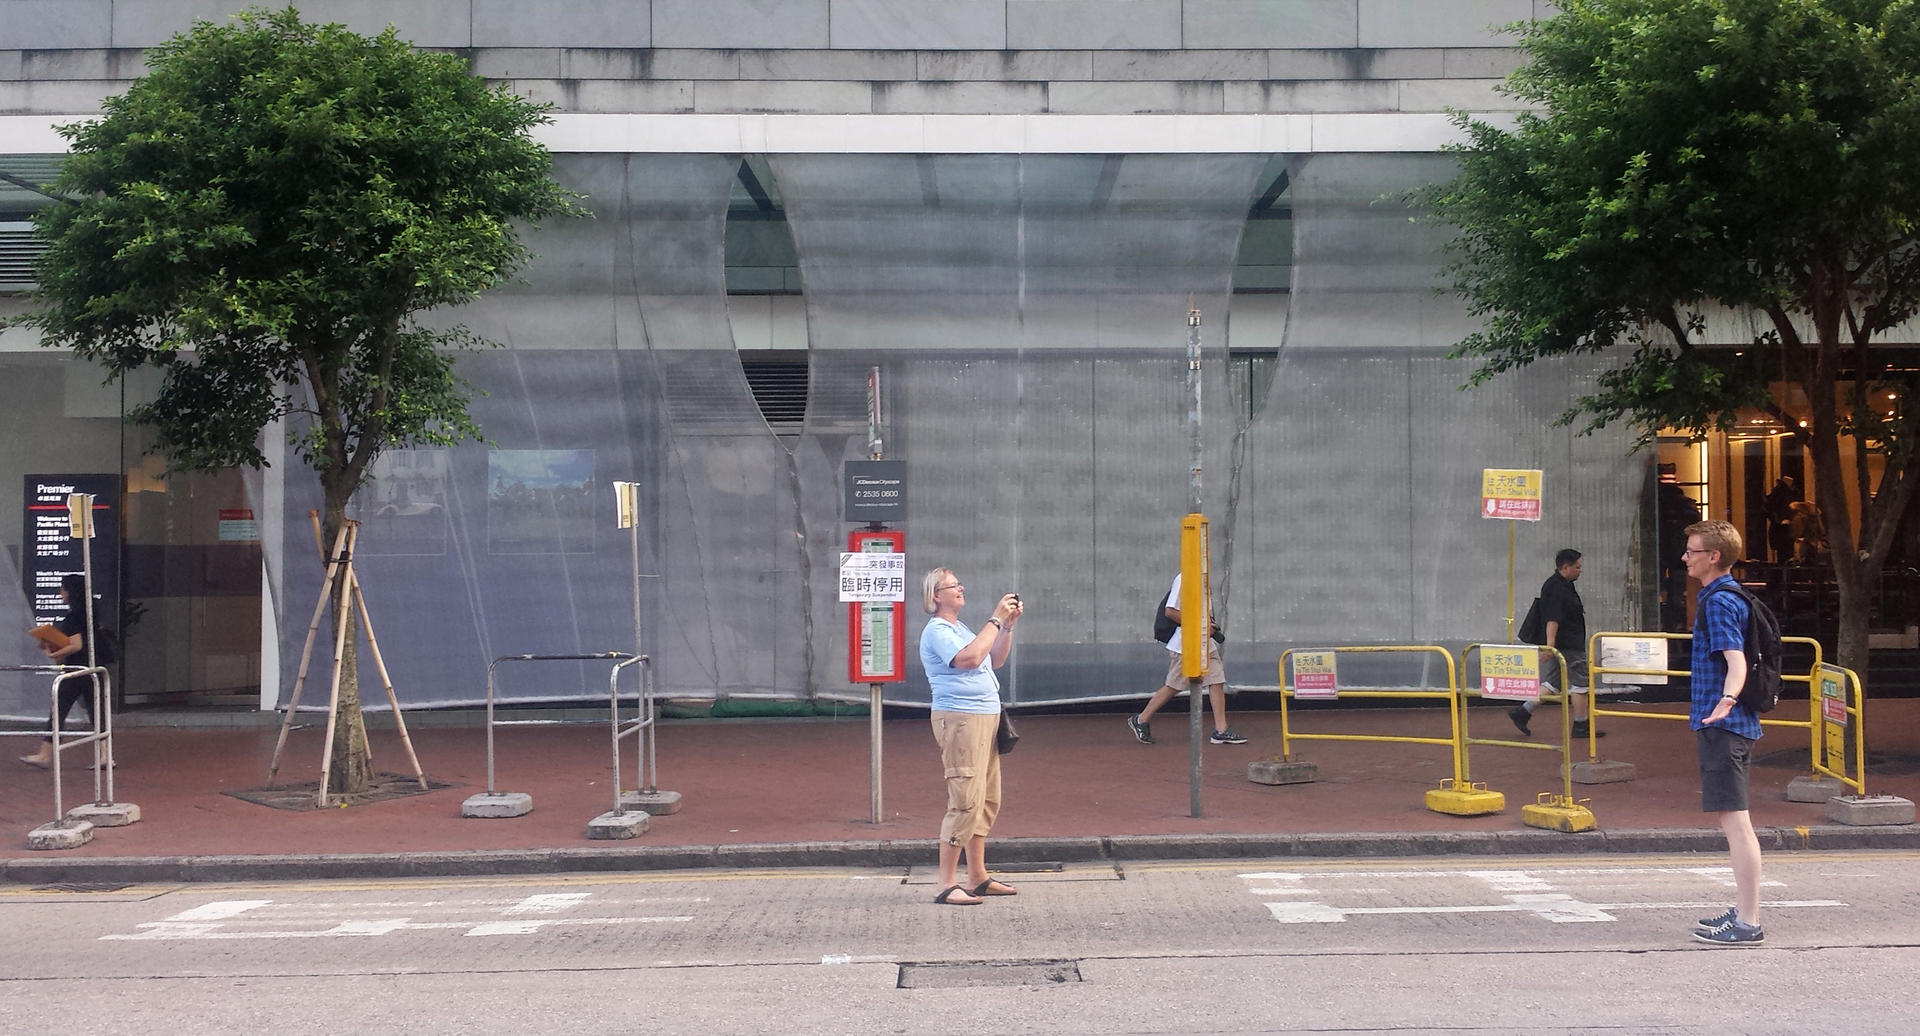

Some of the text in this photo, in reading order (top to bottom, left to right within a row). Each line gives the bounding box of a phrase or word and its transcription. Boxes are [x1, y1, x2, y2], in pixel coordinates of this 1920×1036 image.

[37, 484, 75, 494] Premier
[1496, 488, 1506, 496] Tin
[863, 490, 899, 498] 2535 0600
[869, 560, 904, 569] 突發事故
[841, 577, 903, 592] 臨時停用
[1494, 666, 1505, 675] Tin
